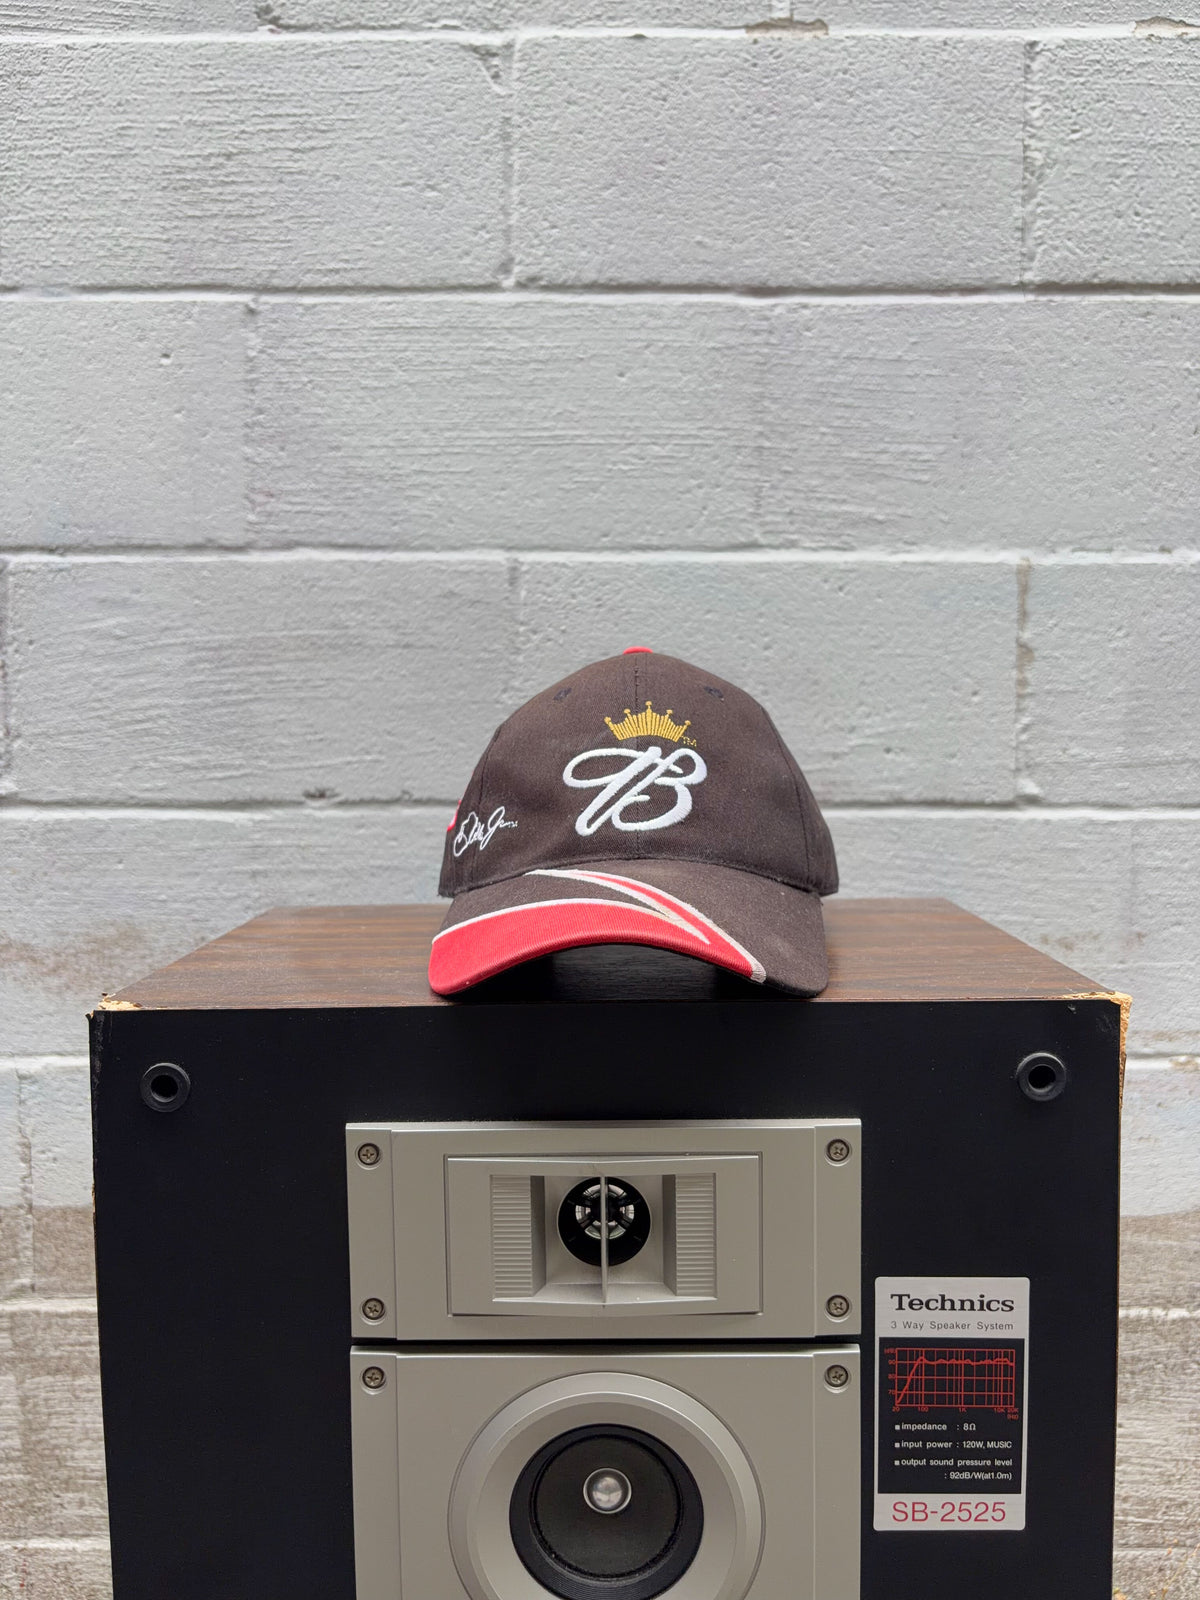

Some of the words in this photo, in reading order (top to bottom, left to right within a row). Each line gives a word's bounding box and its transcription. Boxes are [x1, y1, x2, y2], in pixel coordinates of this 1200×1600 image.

[890, 1293, 1015, 1312] Technics
[890, 1320, 897, 1330] 3
[902, 1320, 924, 1331] Way
[929, 1321, 971, 1331] Speaker
[976, 1321, 1014, 1331] System
[901, 1422, 947, 1432] impedance
[901, 1440, 923, 1450] input
[926, 1442, 953, 1450] power
[987, 1440, 1013, 1449] MUSIC
[901, 1458, 926, 1467] output
[929, 1458, 954, 1466] sound
[994, 1458, 1013, 1466] level
[892, 1501, 1006, 1523] SB-2525
